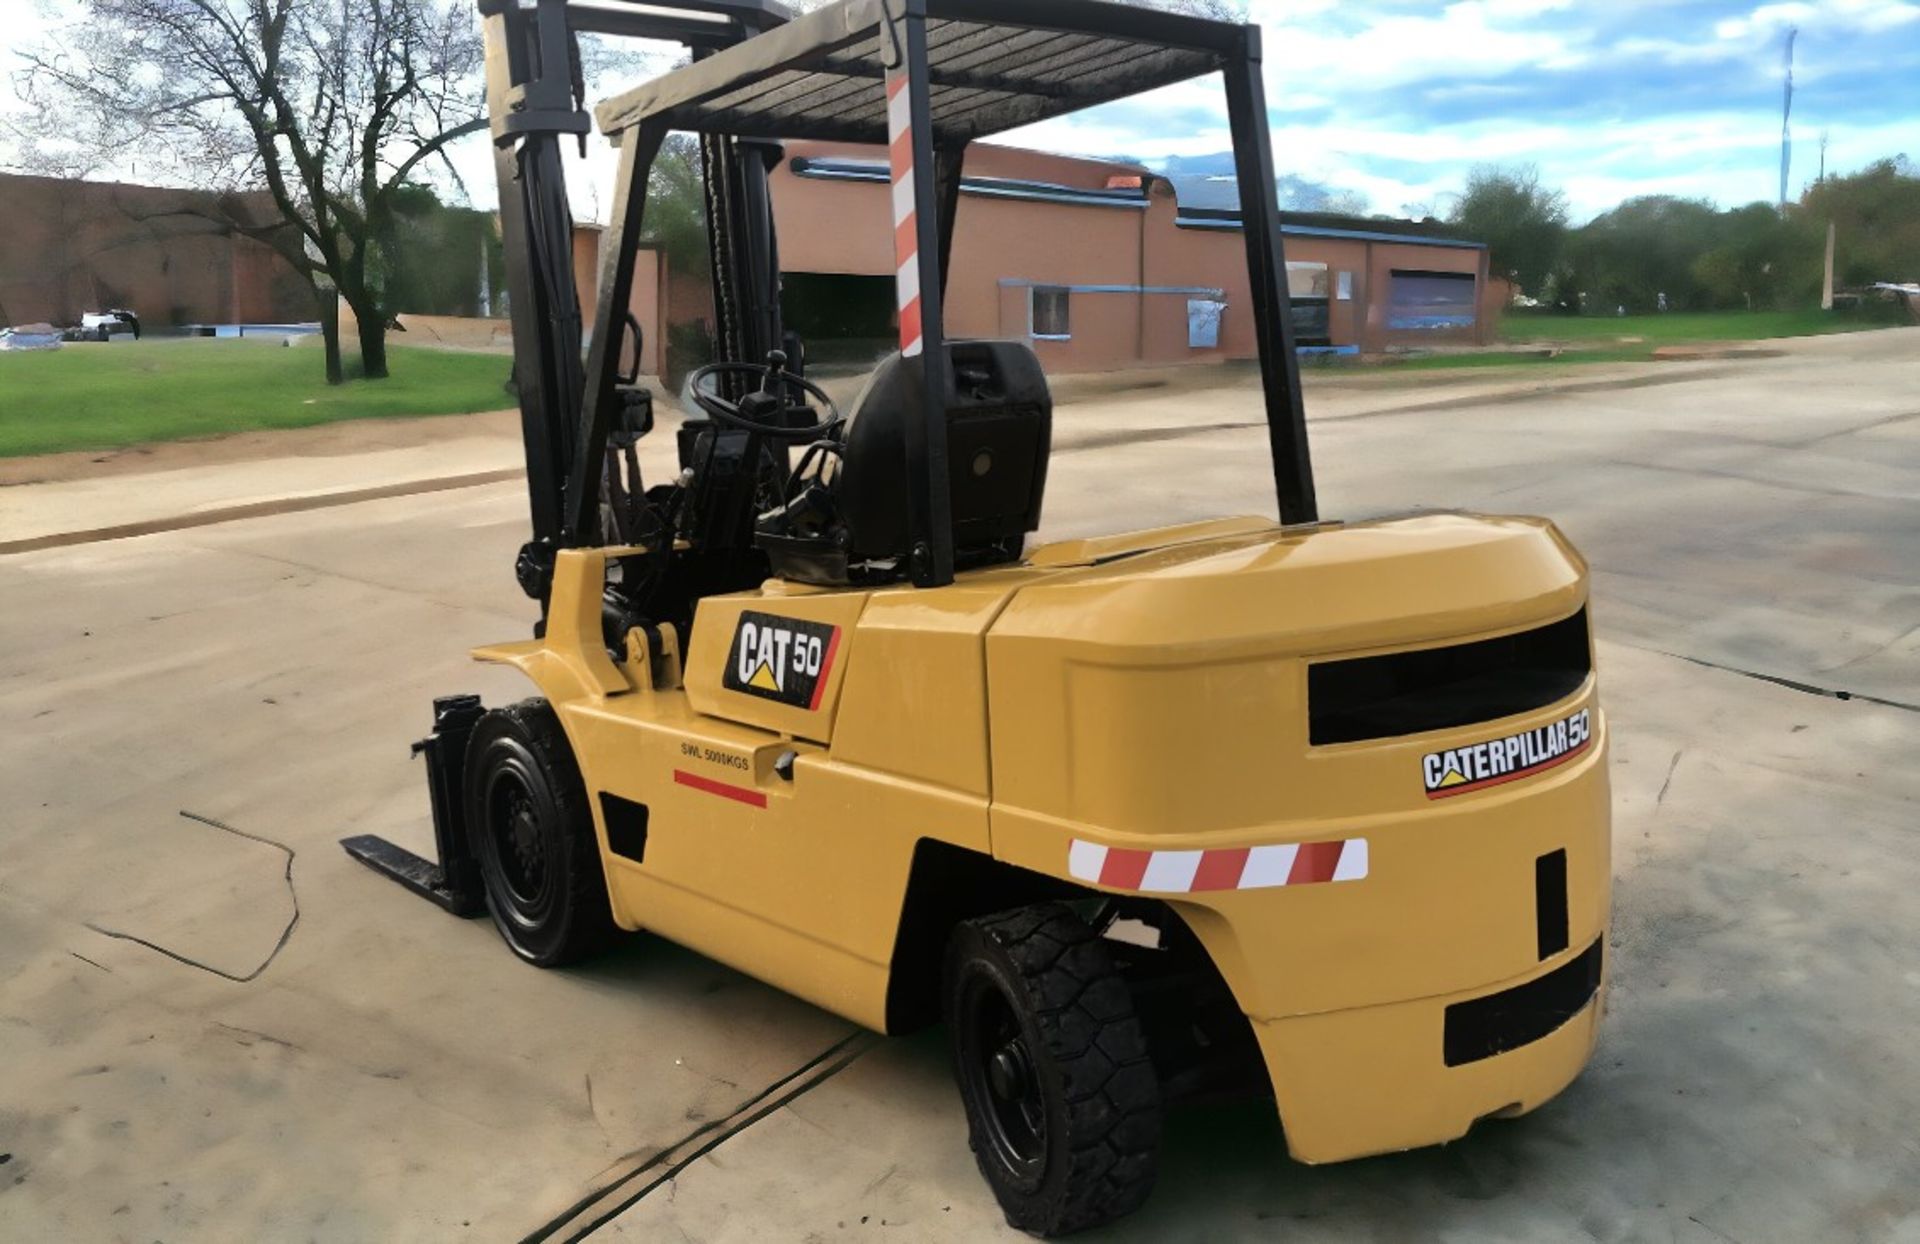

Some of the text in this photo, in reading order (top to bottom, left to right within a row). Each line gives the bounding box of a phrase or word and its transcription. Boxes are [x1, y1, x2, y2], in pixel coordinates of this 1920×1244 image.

[738, 622, 821, 692] CAT 50
[681, 742, 702, 759] SWL
[1423, 708, 1590, 789] CATERPILLAR 50
